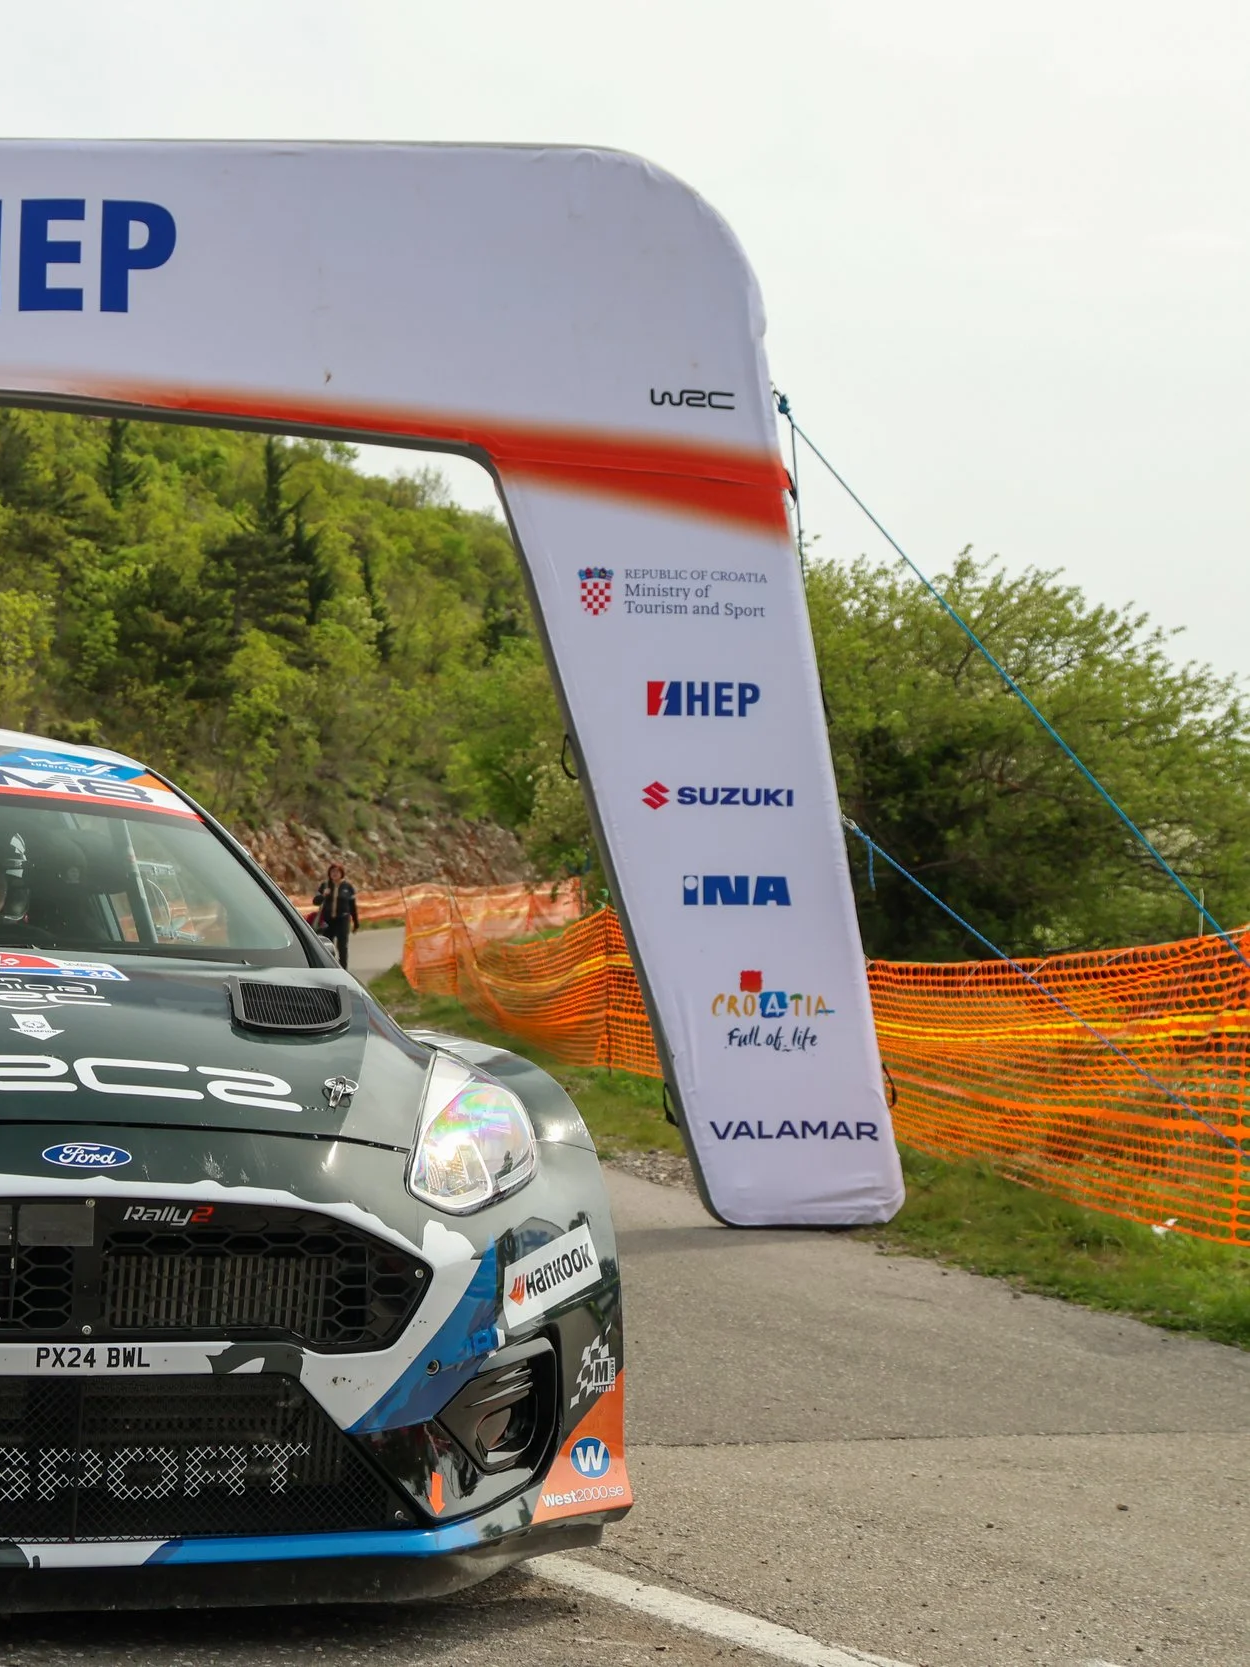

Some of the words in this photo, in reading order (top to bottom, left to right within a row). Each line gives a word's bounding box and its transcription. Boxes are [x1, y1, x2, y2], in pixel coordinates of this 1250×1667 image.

[650, 388, 735, 410] WRC
[625, 568, 688, 580] REPUBLIC
[690, 570, 708, 581] OF
[711, 571, 768, 584] CROATIA
[624, 583, 691, 600] Ministry
[695, 584, 712, 599] of
[624, 600, 688, 615] Tourism
[692, 602, 720, 616] and
[724, 602, 766, 620] Sport
[686, 681, 761, 717] HEP
[677, 786, 794, 807] SUZUKI
[711, 991, 830, 1019] CROATIA
[727, 1025, 761, 1047] Full
[765, 1026, 784, 1051] of
[792, 1027, 818, 1051] life
[710, 1120, 879, 1141] VALAMAR
[58, 1143, 117, 1166] Ford
[123, 1206, 215, 1227] Rally2
[36, 1347, 97, 1368] PX24
[106, 1347, 151, 1368] BWL
[594, 1360, 610, 1384] M
[576, 1442, 607, 1472] W
[541, 1485, 624, 1508] West2000.se
